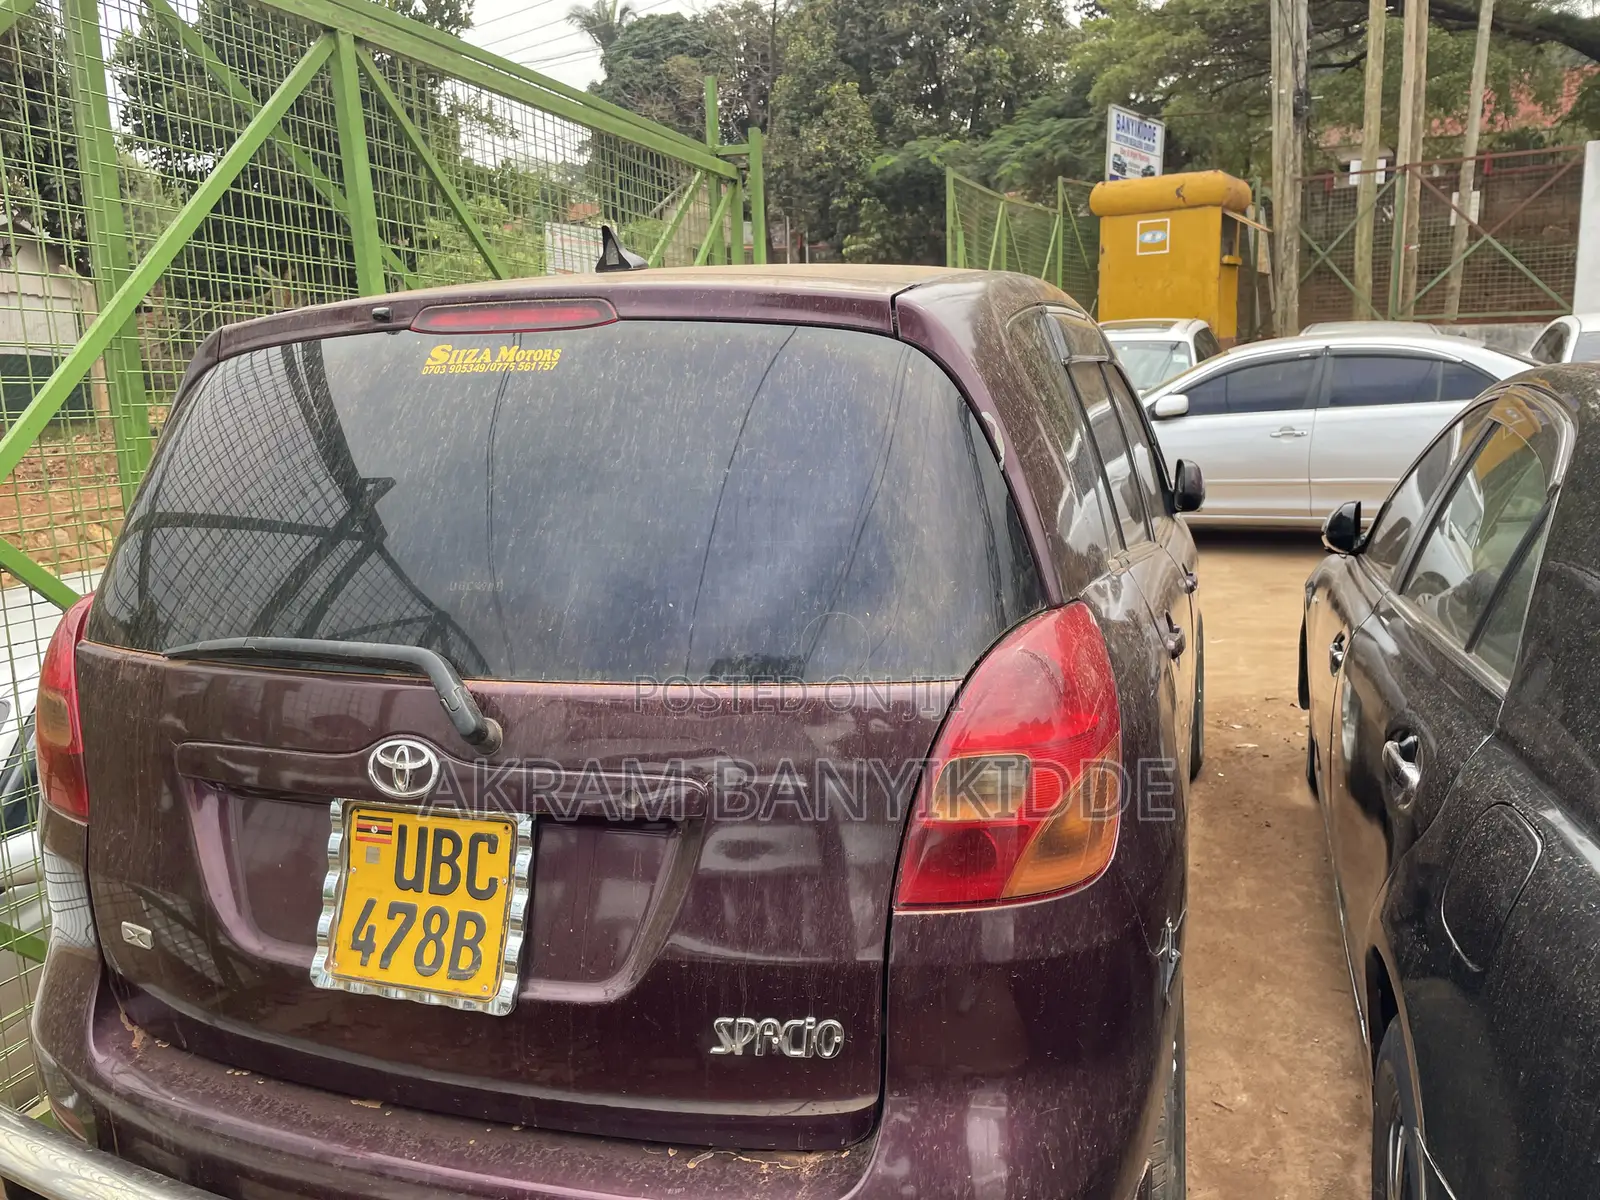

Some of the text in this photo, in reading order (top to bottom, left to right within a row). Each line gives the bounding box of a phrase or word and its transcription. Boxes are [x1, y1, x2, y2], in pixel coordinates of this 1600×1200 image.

[422, 365, 446, 375] 0703
[448, 362, 516, 373] 905349/0775
[394, 824, 499, 901] UBC
[350, 897, 487, 981] 478B
